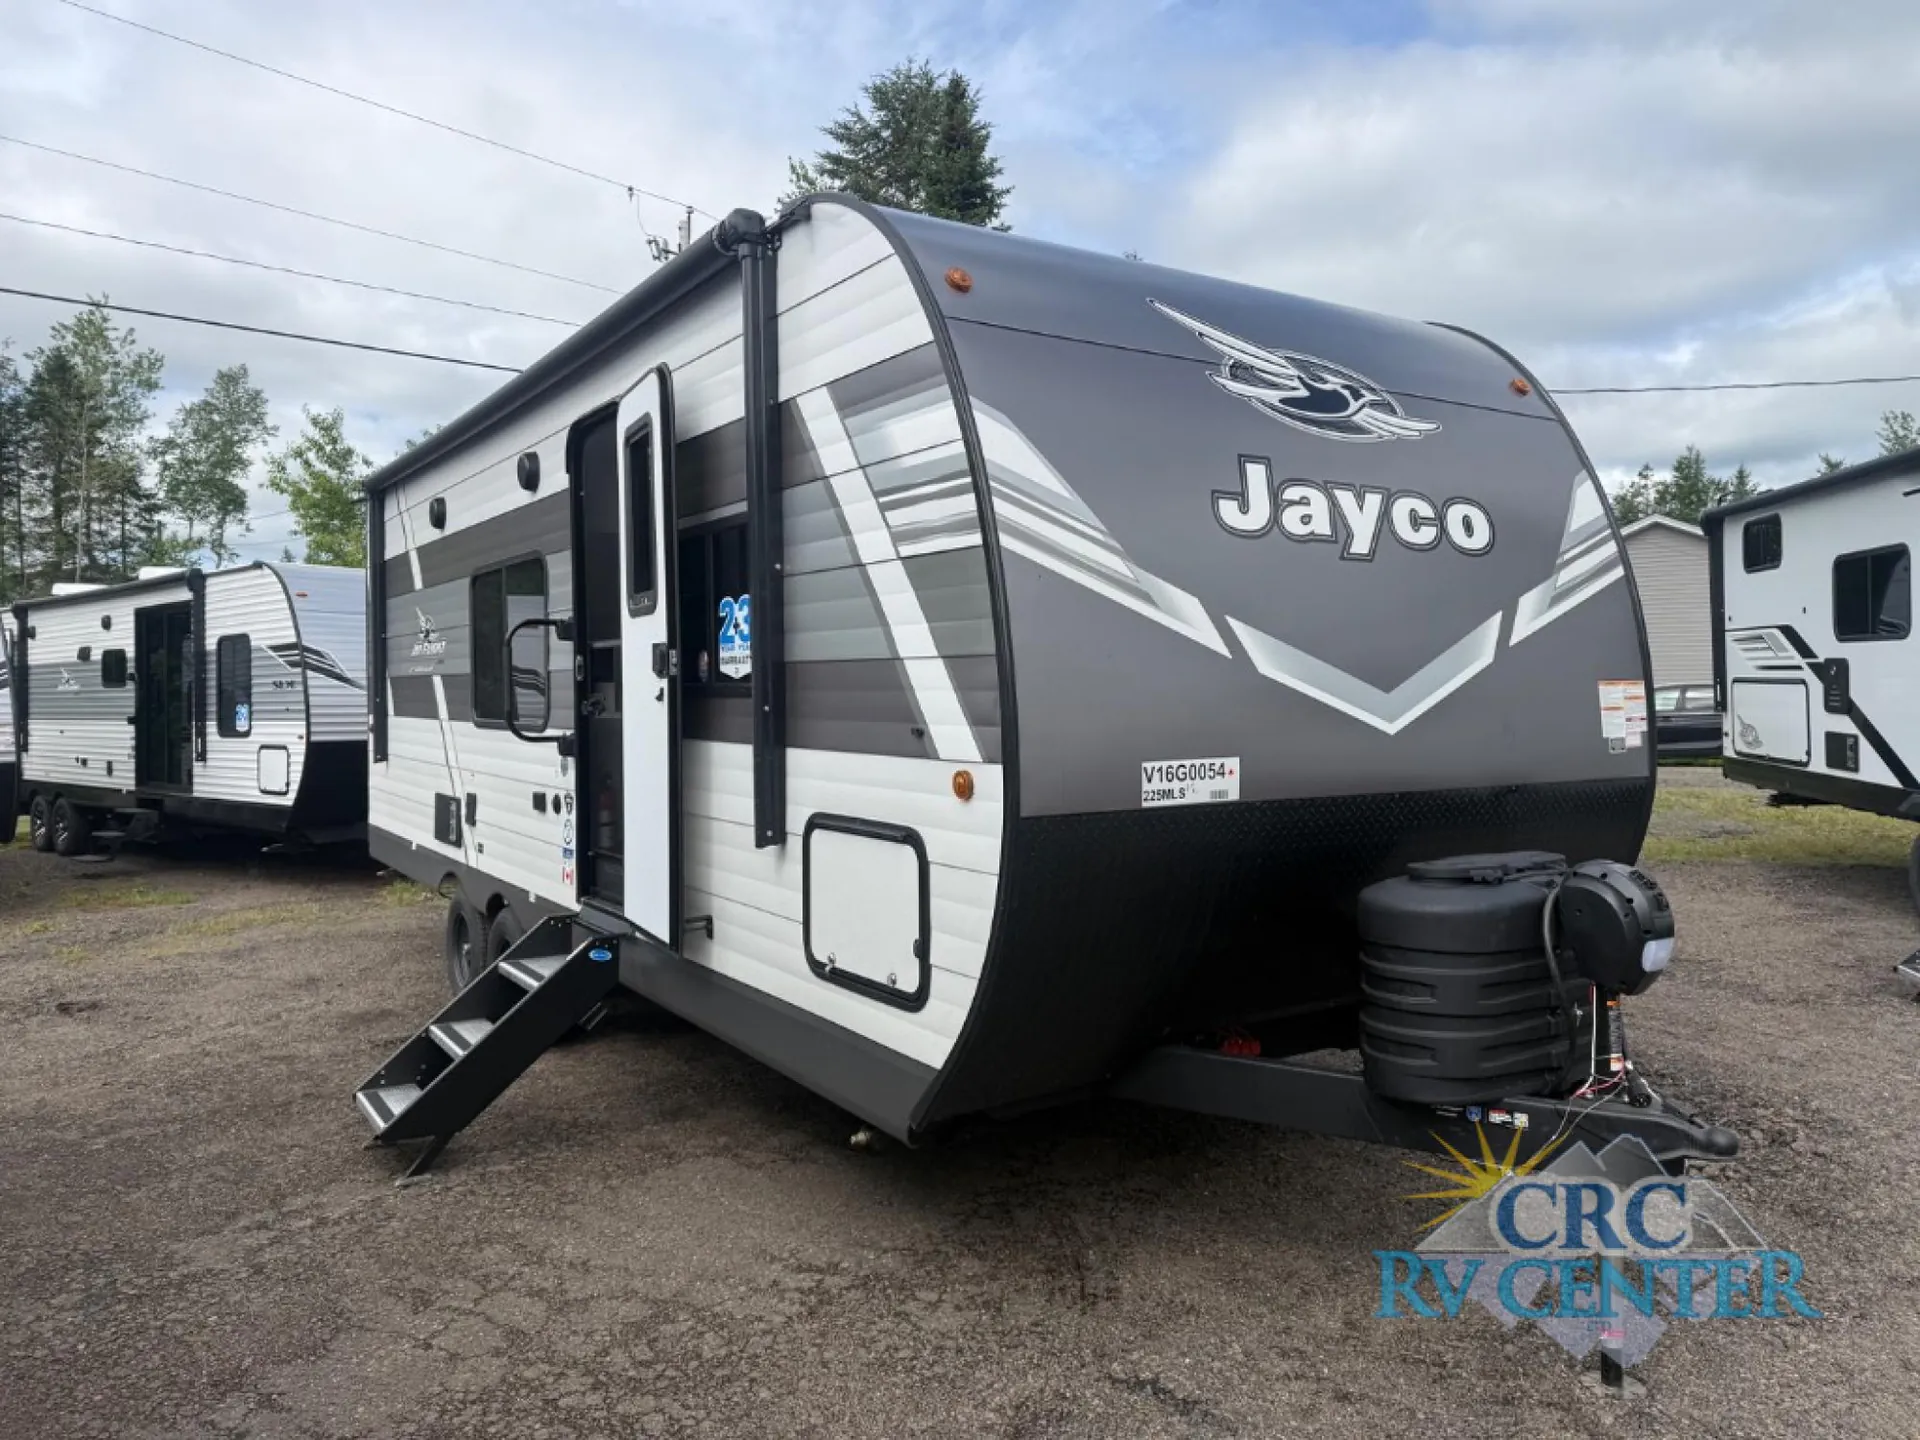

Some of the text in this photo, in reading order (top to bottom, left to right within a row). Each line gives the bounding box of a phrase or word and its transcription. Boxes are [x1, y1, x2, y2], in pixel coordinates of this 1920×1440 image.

[1211, 454, 1495, 562] Jayco
[1143, 762, 1226, 784] V16G0054
[1143, 787, 1186, 802] 225MLS
